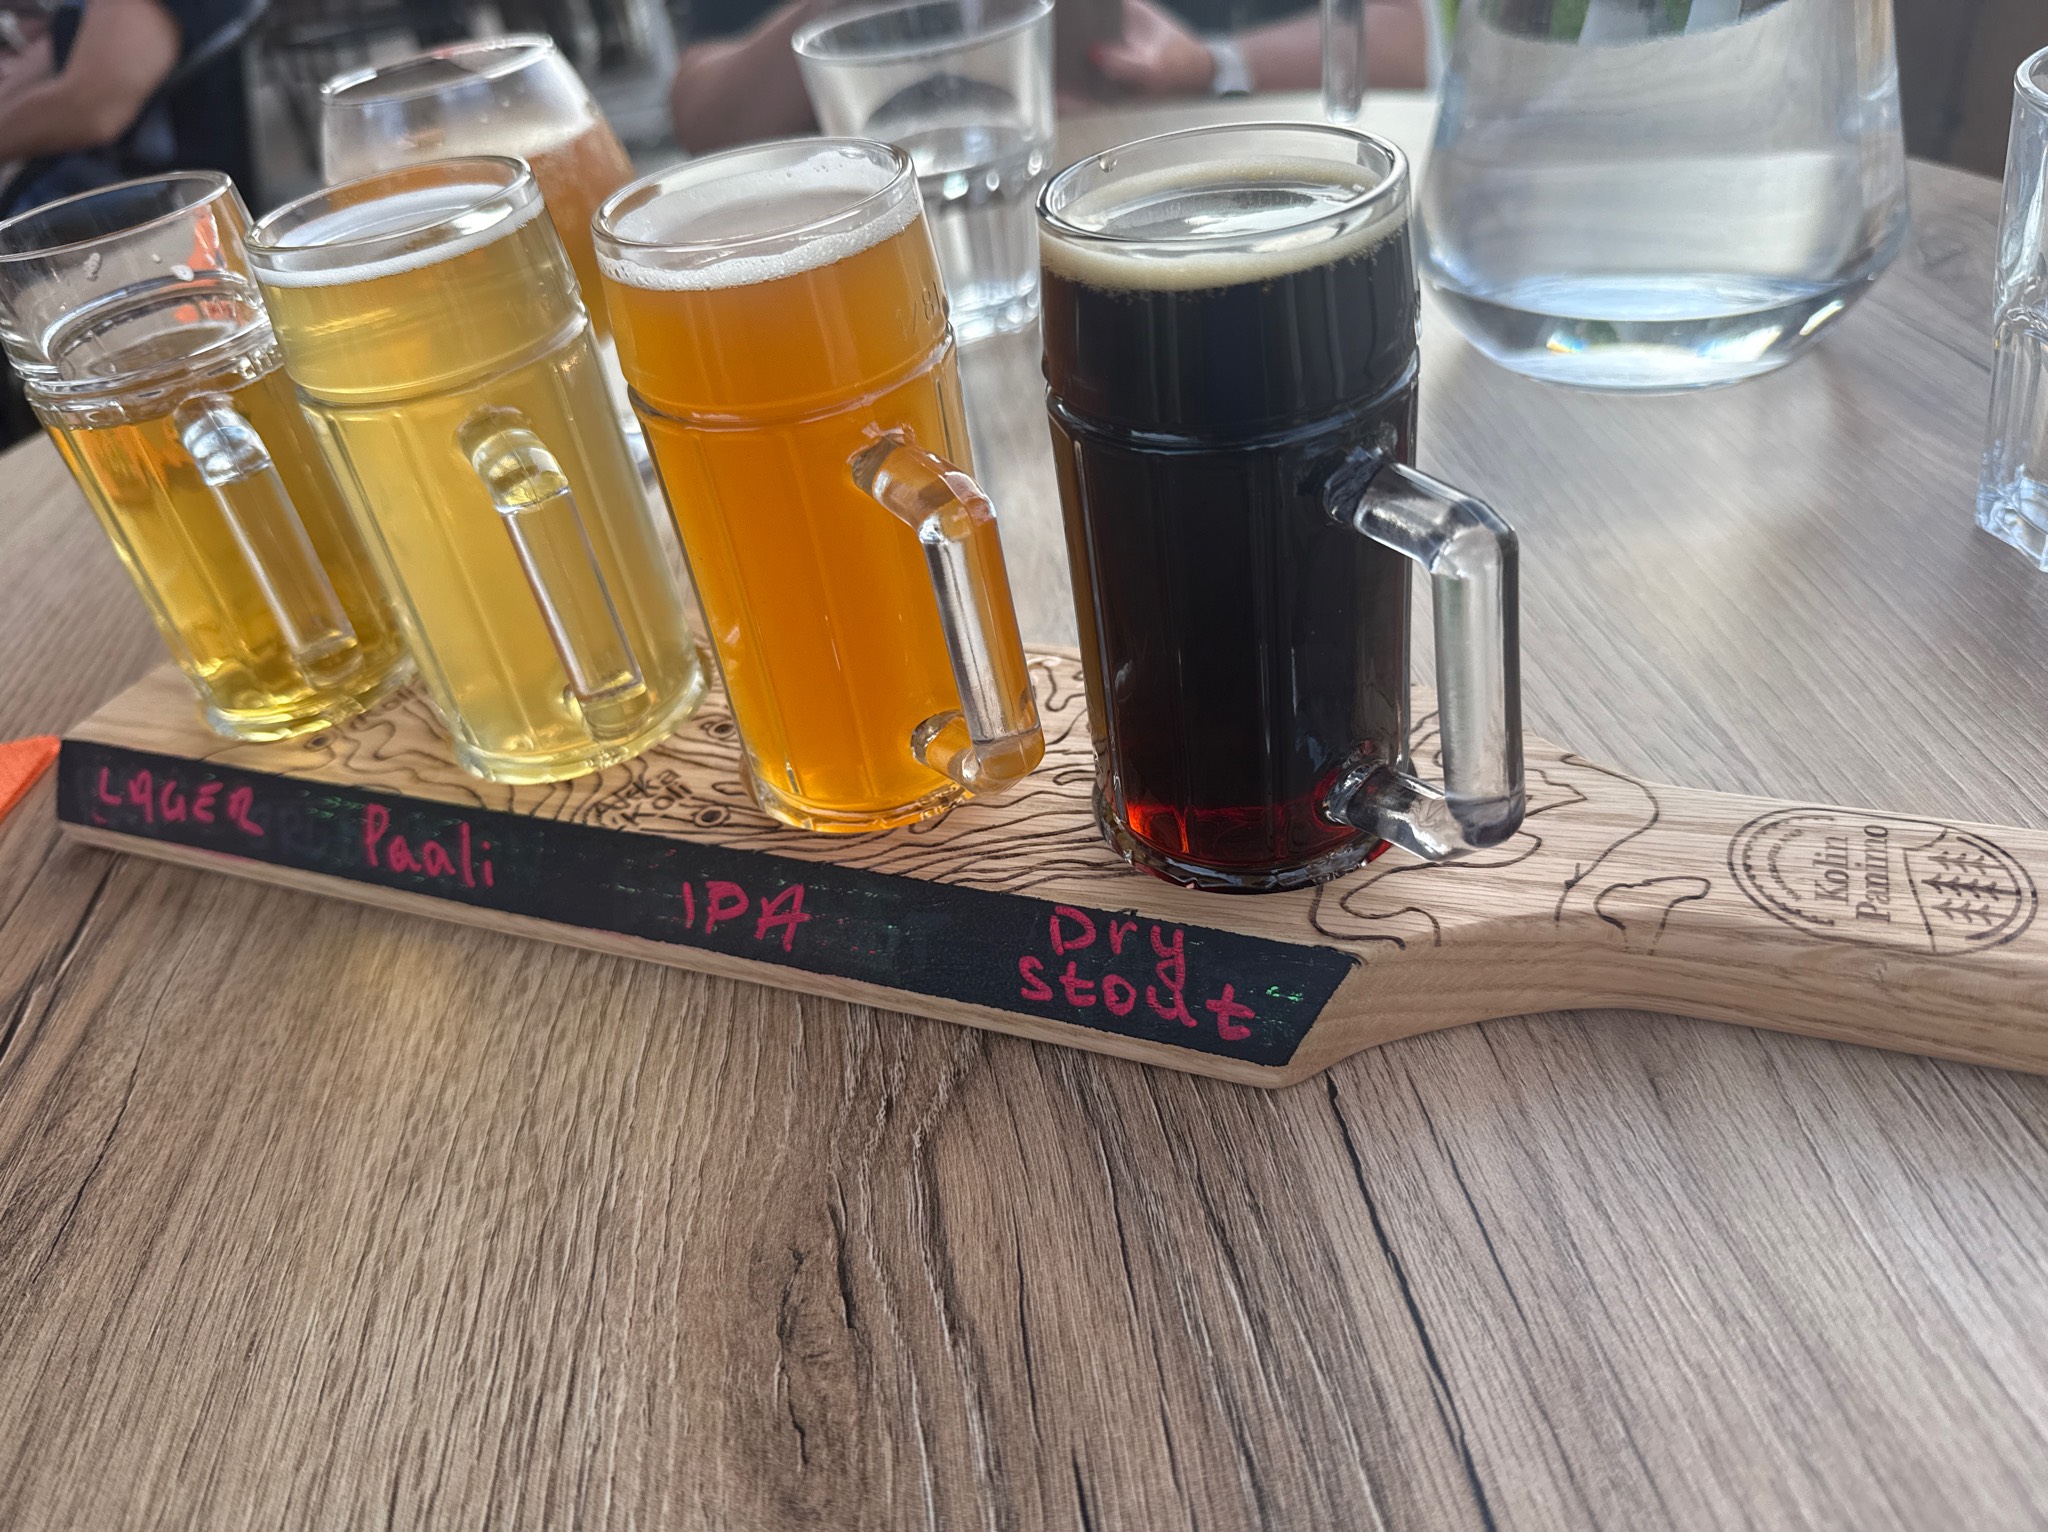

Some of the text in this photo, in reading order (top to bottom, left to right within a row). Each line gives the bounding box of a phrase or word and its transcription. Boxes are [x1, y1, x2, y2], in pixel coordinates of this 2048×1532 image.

[98, 766, 265, 837] LAGER
[363, 802, 494, 888] Paali
[1812, 836, 1850, 905] Kolin
[1855, 824, 1890, 924] Panimo
[681, 880, 812, 953] IPA
[1049, 904, 1189, 985] Dry
